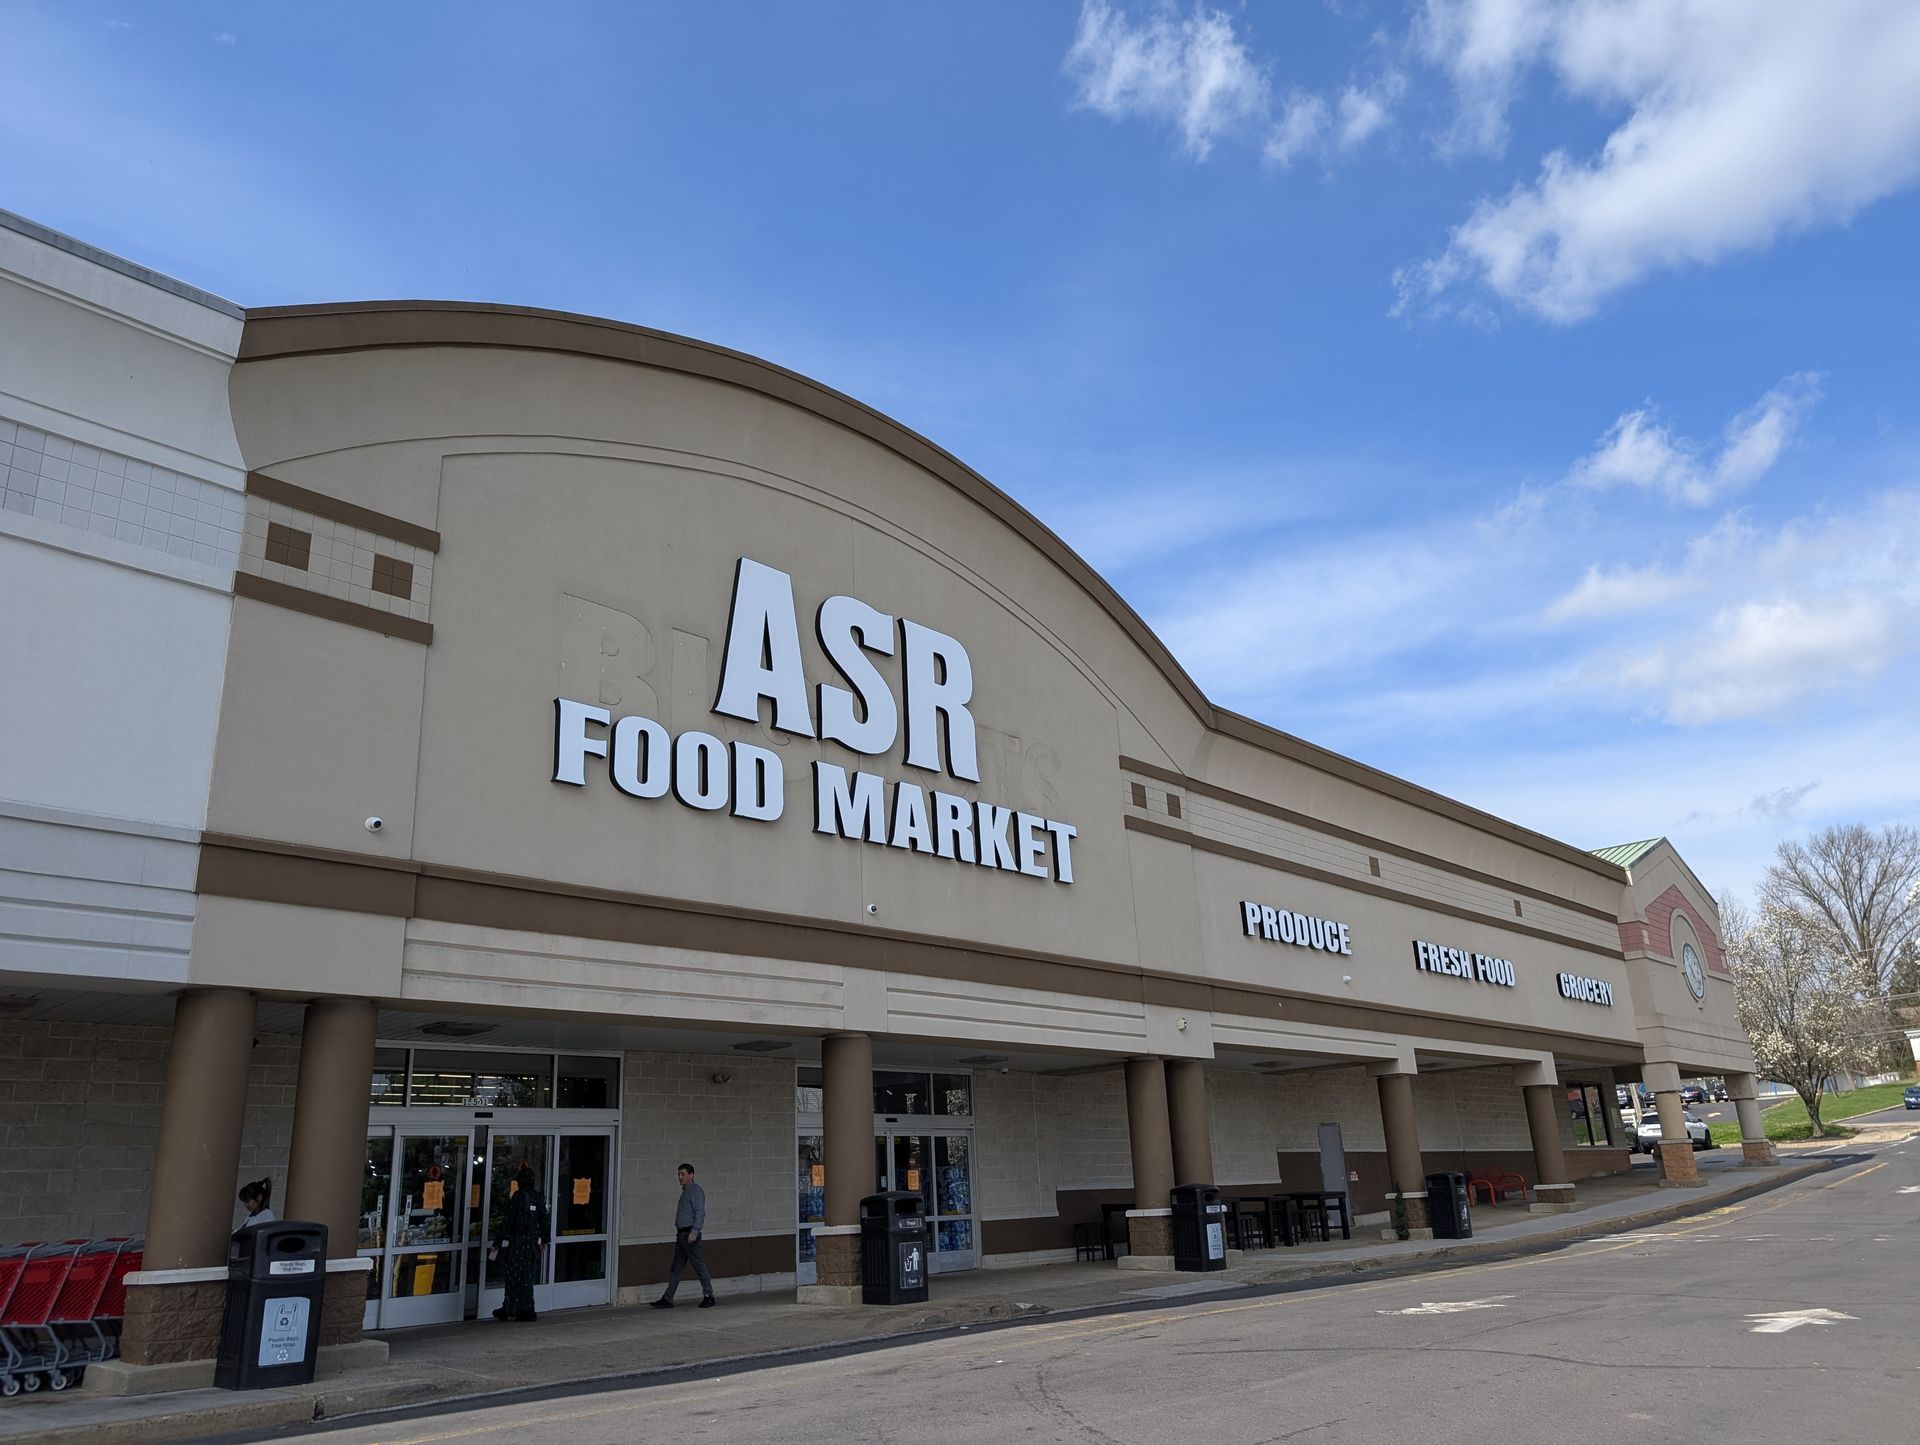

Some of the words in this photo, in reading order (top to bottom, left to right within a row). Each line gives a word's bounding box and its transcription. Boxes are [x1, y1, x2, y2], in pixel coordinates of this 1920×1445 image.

[710, 557, 981, 784] ASR
[551, 697, 785, 822] FOOD
[810, 760, 1078, 884] MARKET
[1239, 900, 1352, 956] PRODUCE
[1412, 940, 1472, 979] FRESH
[1472, 953, 1515, 987] FOOD
[1556, 973, 1615, 1006] GROCERY
